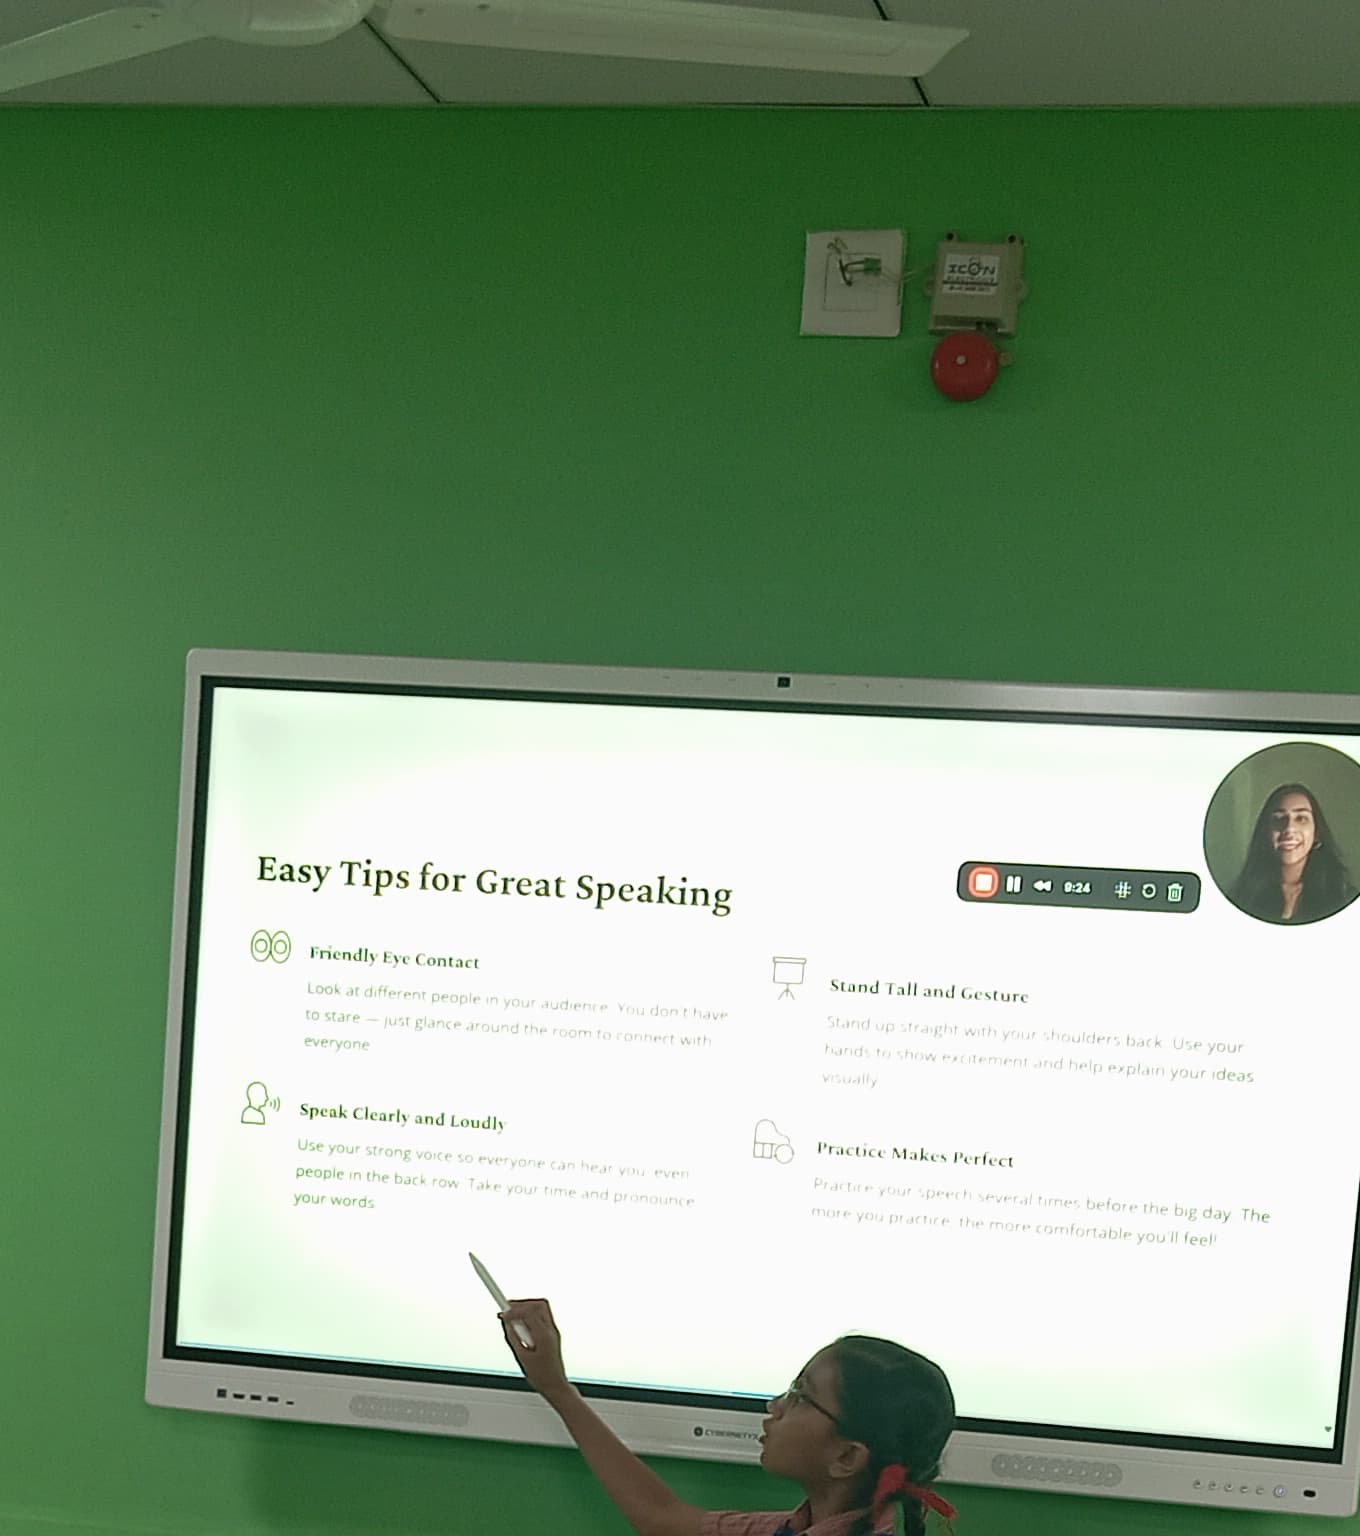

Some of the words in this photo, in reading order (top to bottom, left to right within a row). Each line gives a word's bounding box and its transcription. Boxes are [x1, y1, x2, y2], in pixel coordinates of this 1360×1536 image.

[948, 260, 996, 275] ICON
[257, 856, 332, 892] Easy
[340, 859, 410, 896] Tips
[419, 862, 467, 893] for
[476, 869, 566, 899] Great
[576, 875, 733, 917] Speaking
[310, 946, 378, 966] Friendly
[383, 951, 410, 968] Eye
[415, 953, 480, 970] Contact
[307, 982, 340, 996] Look
[345, 985, 359, 997] at
[364, 984, 427, 1001] different
[431, 992, 481, 1006] people
[486, 994, 498, 1005] in
[503, 997, 536, 1010] your
[616, 1002, 645, 1017] You
[693, 1008, 729, 1022] have
[830, 978, 880, 994] Stand
[885, 982, 918, 997] Tall
[923, 985, 956, 999] and
[961, 986, 1029, 1003] Gesture
[305, 1009, 320, 1021] to
[324, 1011, 361, 1024] stare
[383, 1014, 410, 1029] just
[415, 1016, 462, 1031] glance
[466, 1020, 519, 1034] around
[524, 1022, 548, 1035] the
[553, 1027, 592, 1039] room
[596, 1028, 611, 1041] to
[617, 1032, 675, 1046] connect
[680, 1034, 712, 1048] with
[827, 1015, 871, 1031] Stand
[875, 1021, 895, 1034] up
[900, 1022, 959, 1038] straight
[964, 1024, 998, 1037] with
[1002, 1030, 1036, 1042] your
[1043, 1028, 1121, 1047] shoulders
[1173, 1037, 1203, 1051] Use
[1207, 1041, 1244, 1056] your
[824, 1043, 870, 1058] hands
[876, 1047, 891, 1059] to
[897, 1048, 938, 1062] show
[942, 1052, 1028, 1069] excitement
[1033, 1057, 1064, 1071] and
[1069, 1058, 1103, 1076] help
[1108, 1062, 1165, 1078] explain
[1170, 1067, 1206, 1082] your
[1212, 1067, 1254, 1083] ideas
[300, 1103, 348, 1120] Speak
[353, 1106, 410, 1127] Clearly
[415, 1112, 445, 1127] and
[450, 1114, 507, 1134] Loudly
[297, 1138, 324, 1152] Use
[328, 1143, 361, 1156] your
[365, 1144, 412, 1162] strong
[416, 1149, 453, 1163] voice
[458, 1154, 474, 1164] so
[478, 1154, 546, 1170] everyone
[550, 1159, 576, 1171] can
[581, 1160, 613, 1174] hear
[654, 1168, 690, 1180] even
[817, 1141, 887, 1159] Practice
[891, 1147, 948, 1163] Makes
[953, 1151, 1015, 1168] Perfect
[293, 1192, 326, 1207] your
[296, 1166, 345, 1180] people
[349, 1169, 362, 1181] in
[366, 1170, 390, 1184] the
[394, 1172, 427, 1186] back
[468, 1177, 502, 1193] Take
[506, 1183, 538, 1196] your
[544, 1184, 577, 1199] time
[581, 1187, 609, 1201] and
[613, 1190, 695, 1208] pronounce
[814, 1176, 874, 1193] Practice
[878, 1186, 912, 1198] your
[918, 1186, 973, 1201] speech
[978, 1190, 1033, 1206] several
[1038, 1195, 1081, 1209] times
[1086, 1196, 1138, 1213] before
[1143, 1203, 1169, 1216] the
[1174, 1203, 1198, 1222] big
[1241, 1207, 1271, 1224] The
[812, 1206, 852, 1219] more
[856, 1211, 884, 1224] you
[959, 1216, 985, 1230] the
[990, 1220, 1031, 1233] more
[1036, 1222, 1132, 1241] comfortable
